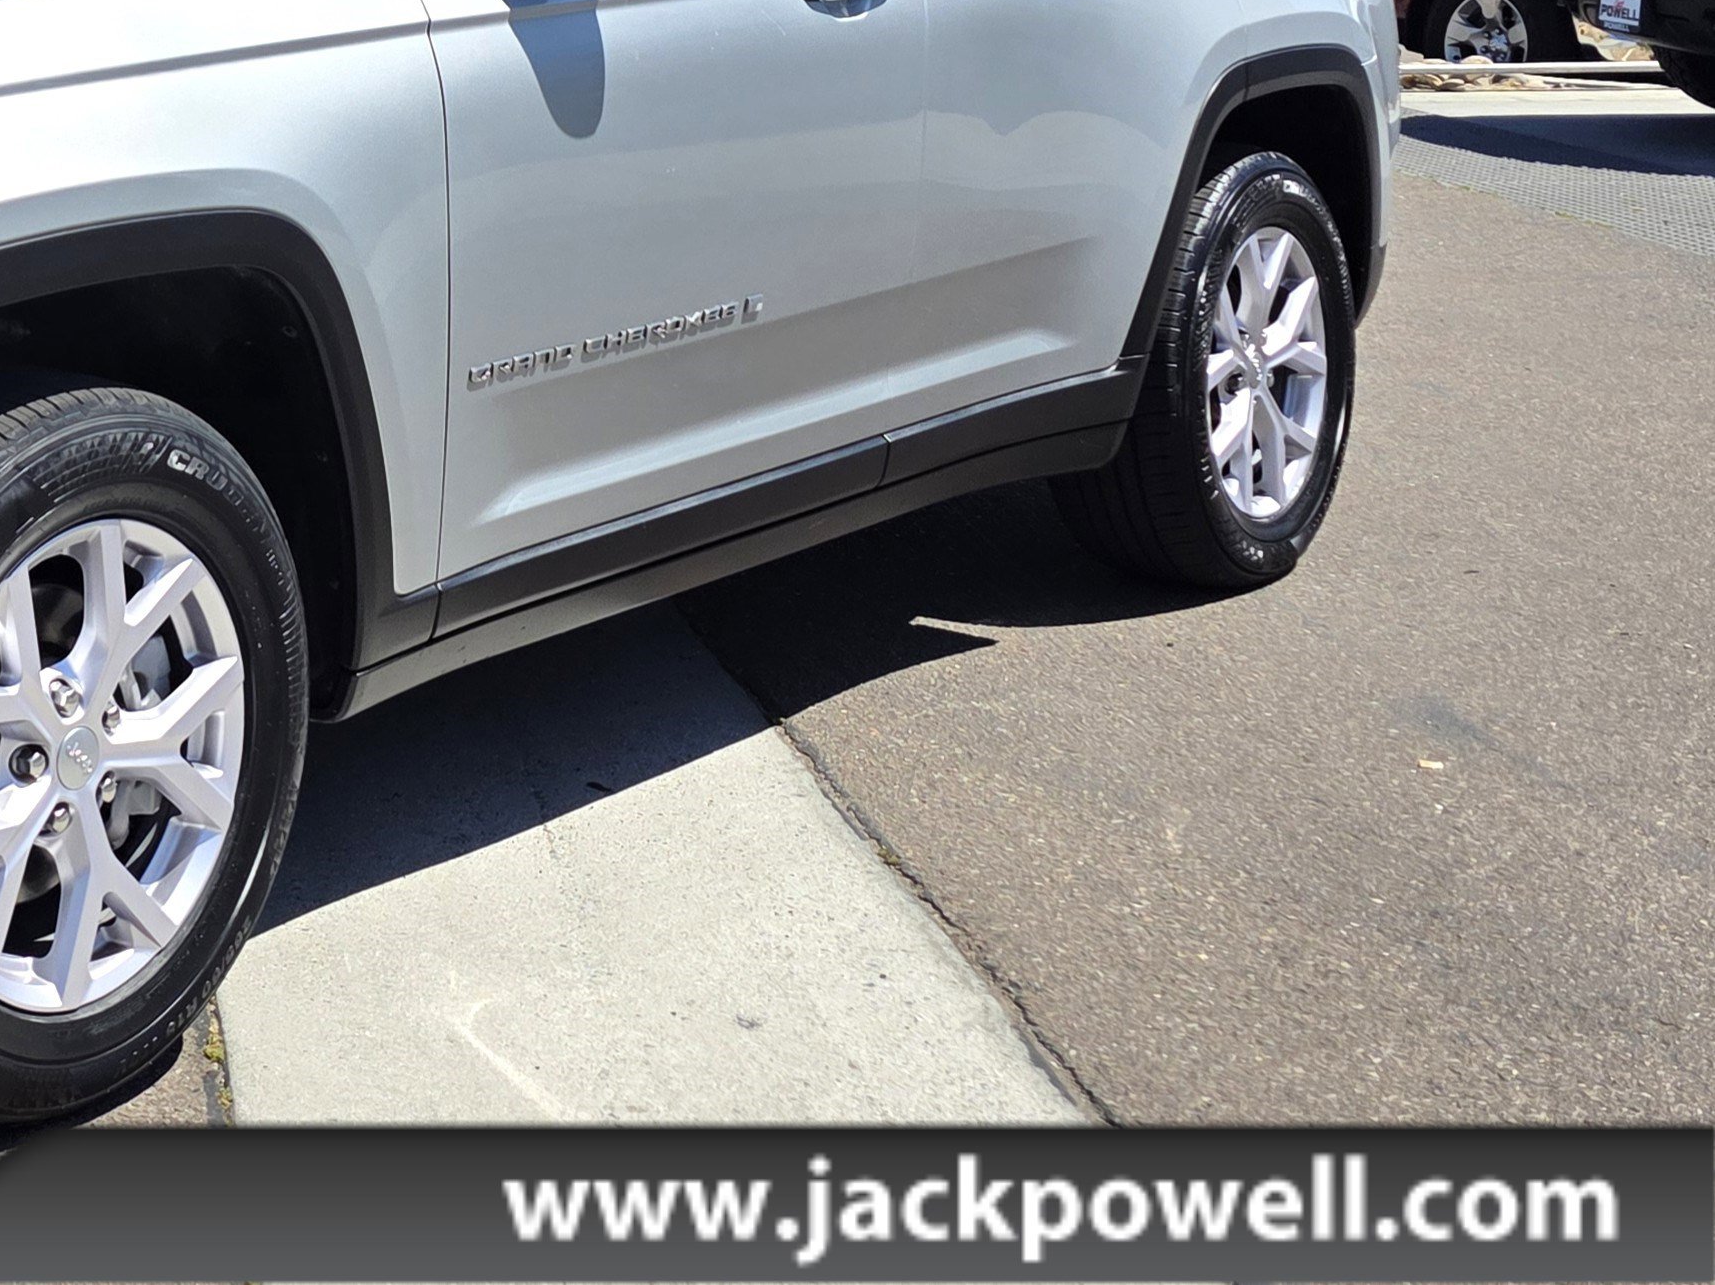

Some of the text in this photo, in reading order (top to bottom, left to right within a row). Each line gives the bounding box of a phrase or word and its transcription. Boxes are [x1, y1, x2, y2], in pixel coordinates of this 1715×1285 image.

[1599, 2, 1640, 21] POWELL
[468, 343, 577, 384] GRAND
[583, 301, 740, 355] CHEROKEE
